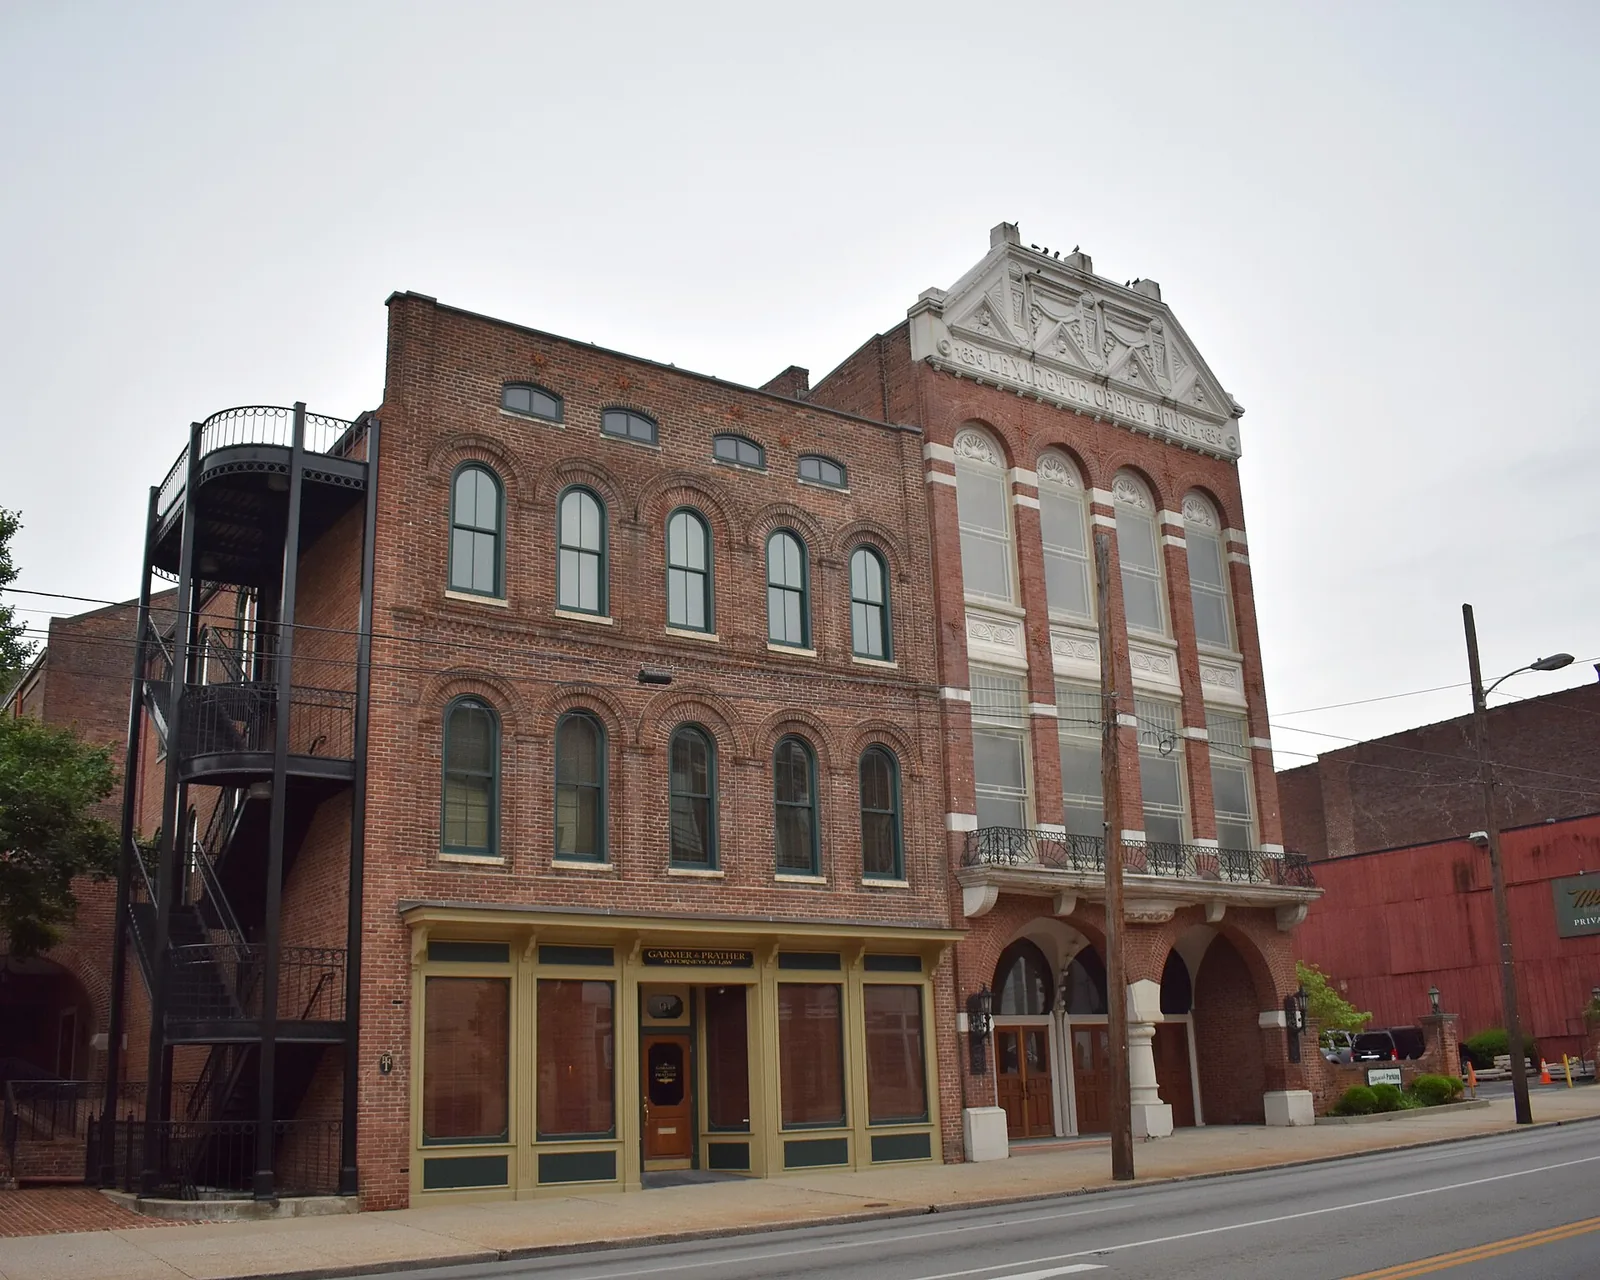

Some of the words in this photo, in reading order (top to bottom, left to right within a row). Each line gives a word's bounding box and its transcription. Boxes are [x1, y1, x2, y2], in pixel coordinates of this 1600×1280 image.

[987, 350, 1090, 404] LEXINGTON
[1094, 389, 1147, 422] OPERA
[648, 950, 693, 959] GARMER
[701, 951, 746, 960] PRATHER
